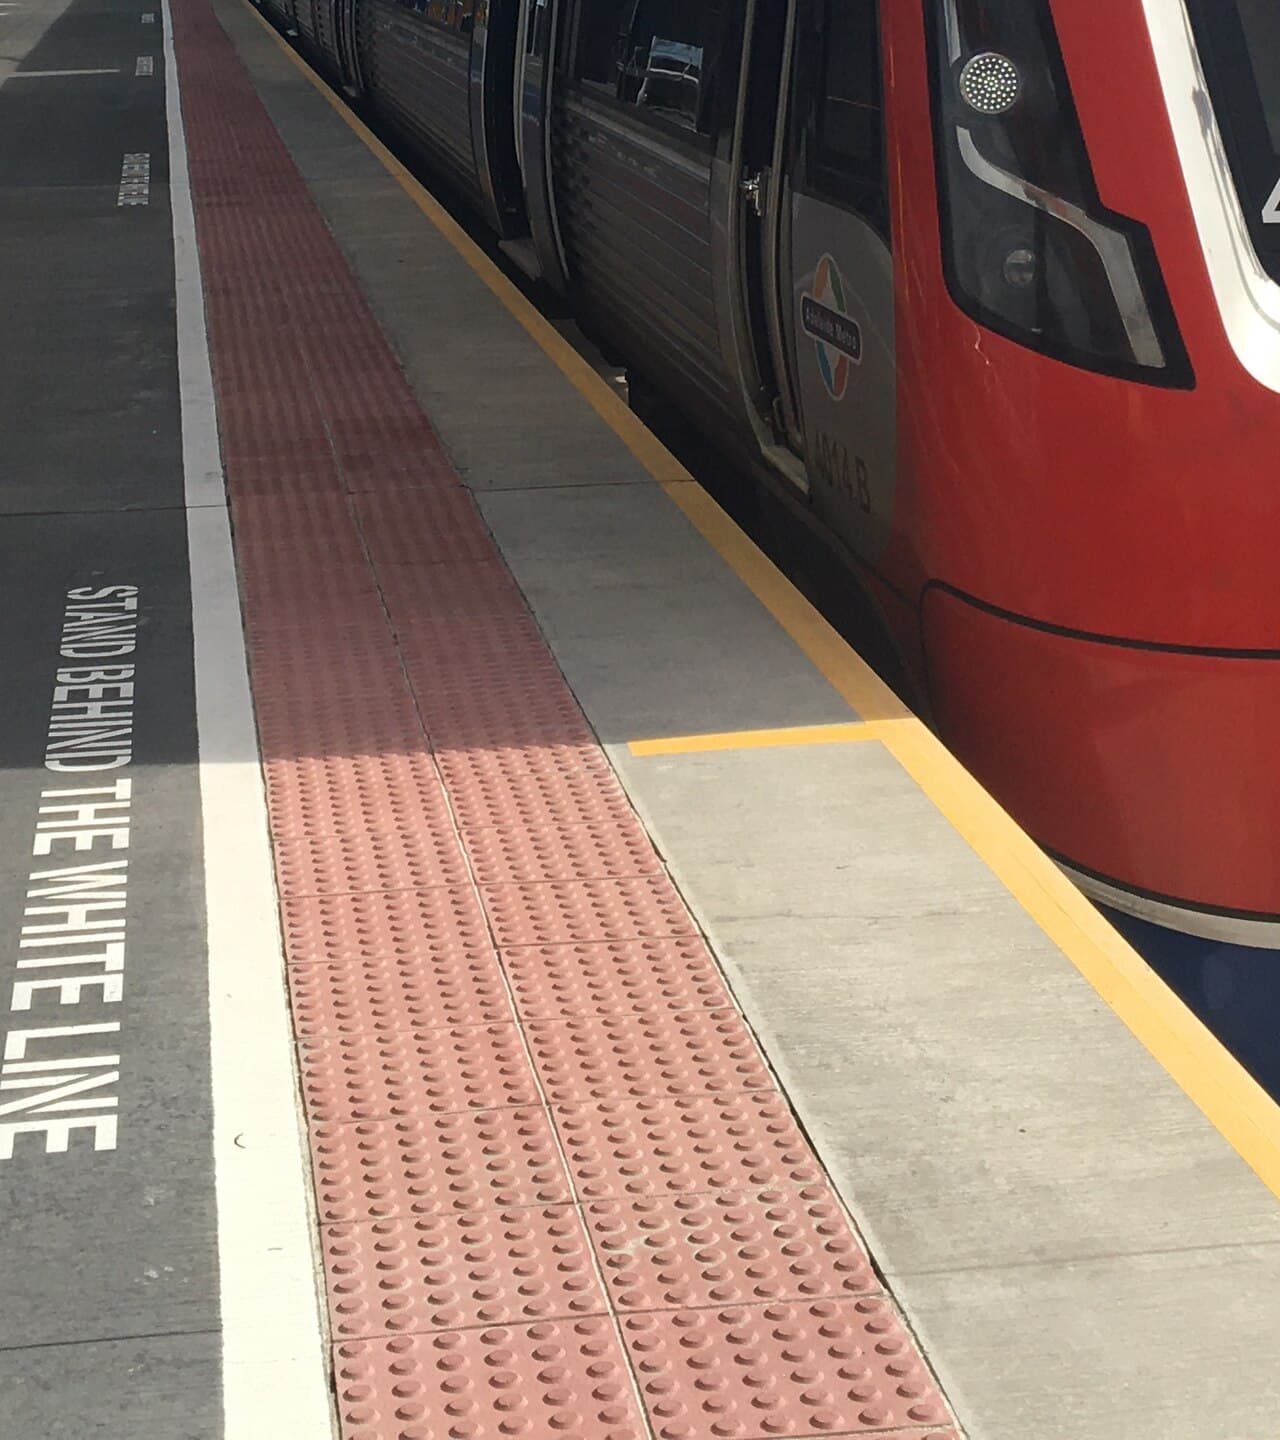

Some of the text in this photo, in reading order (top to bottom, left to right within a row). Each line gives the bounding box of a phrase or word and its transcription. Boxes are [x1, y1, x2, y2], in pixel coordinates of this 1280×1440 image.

[59, 585, 139, 658] STAND
[45, 664, 136, 772] BEHIND
[32, 778, 132, 855] THE
[10, 859, 129, 1011] WHITE
